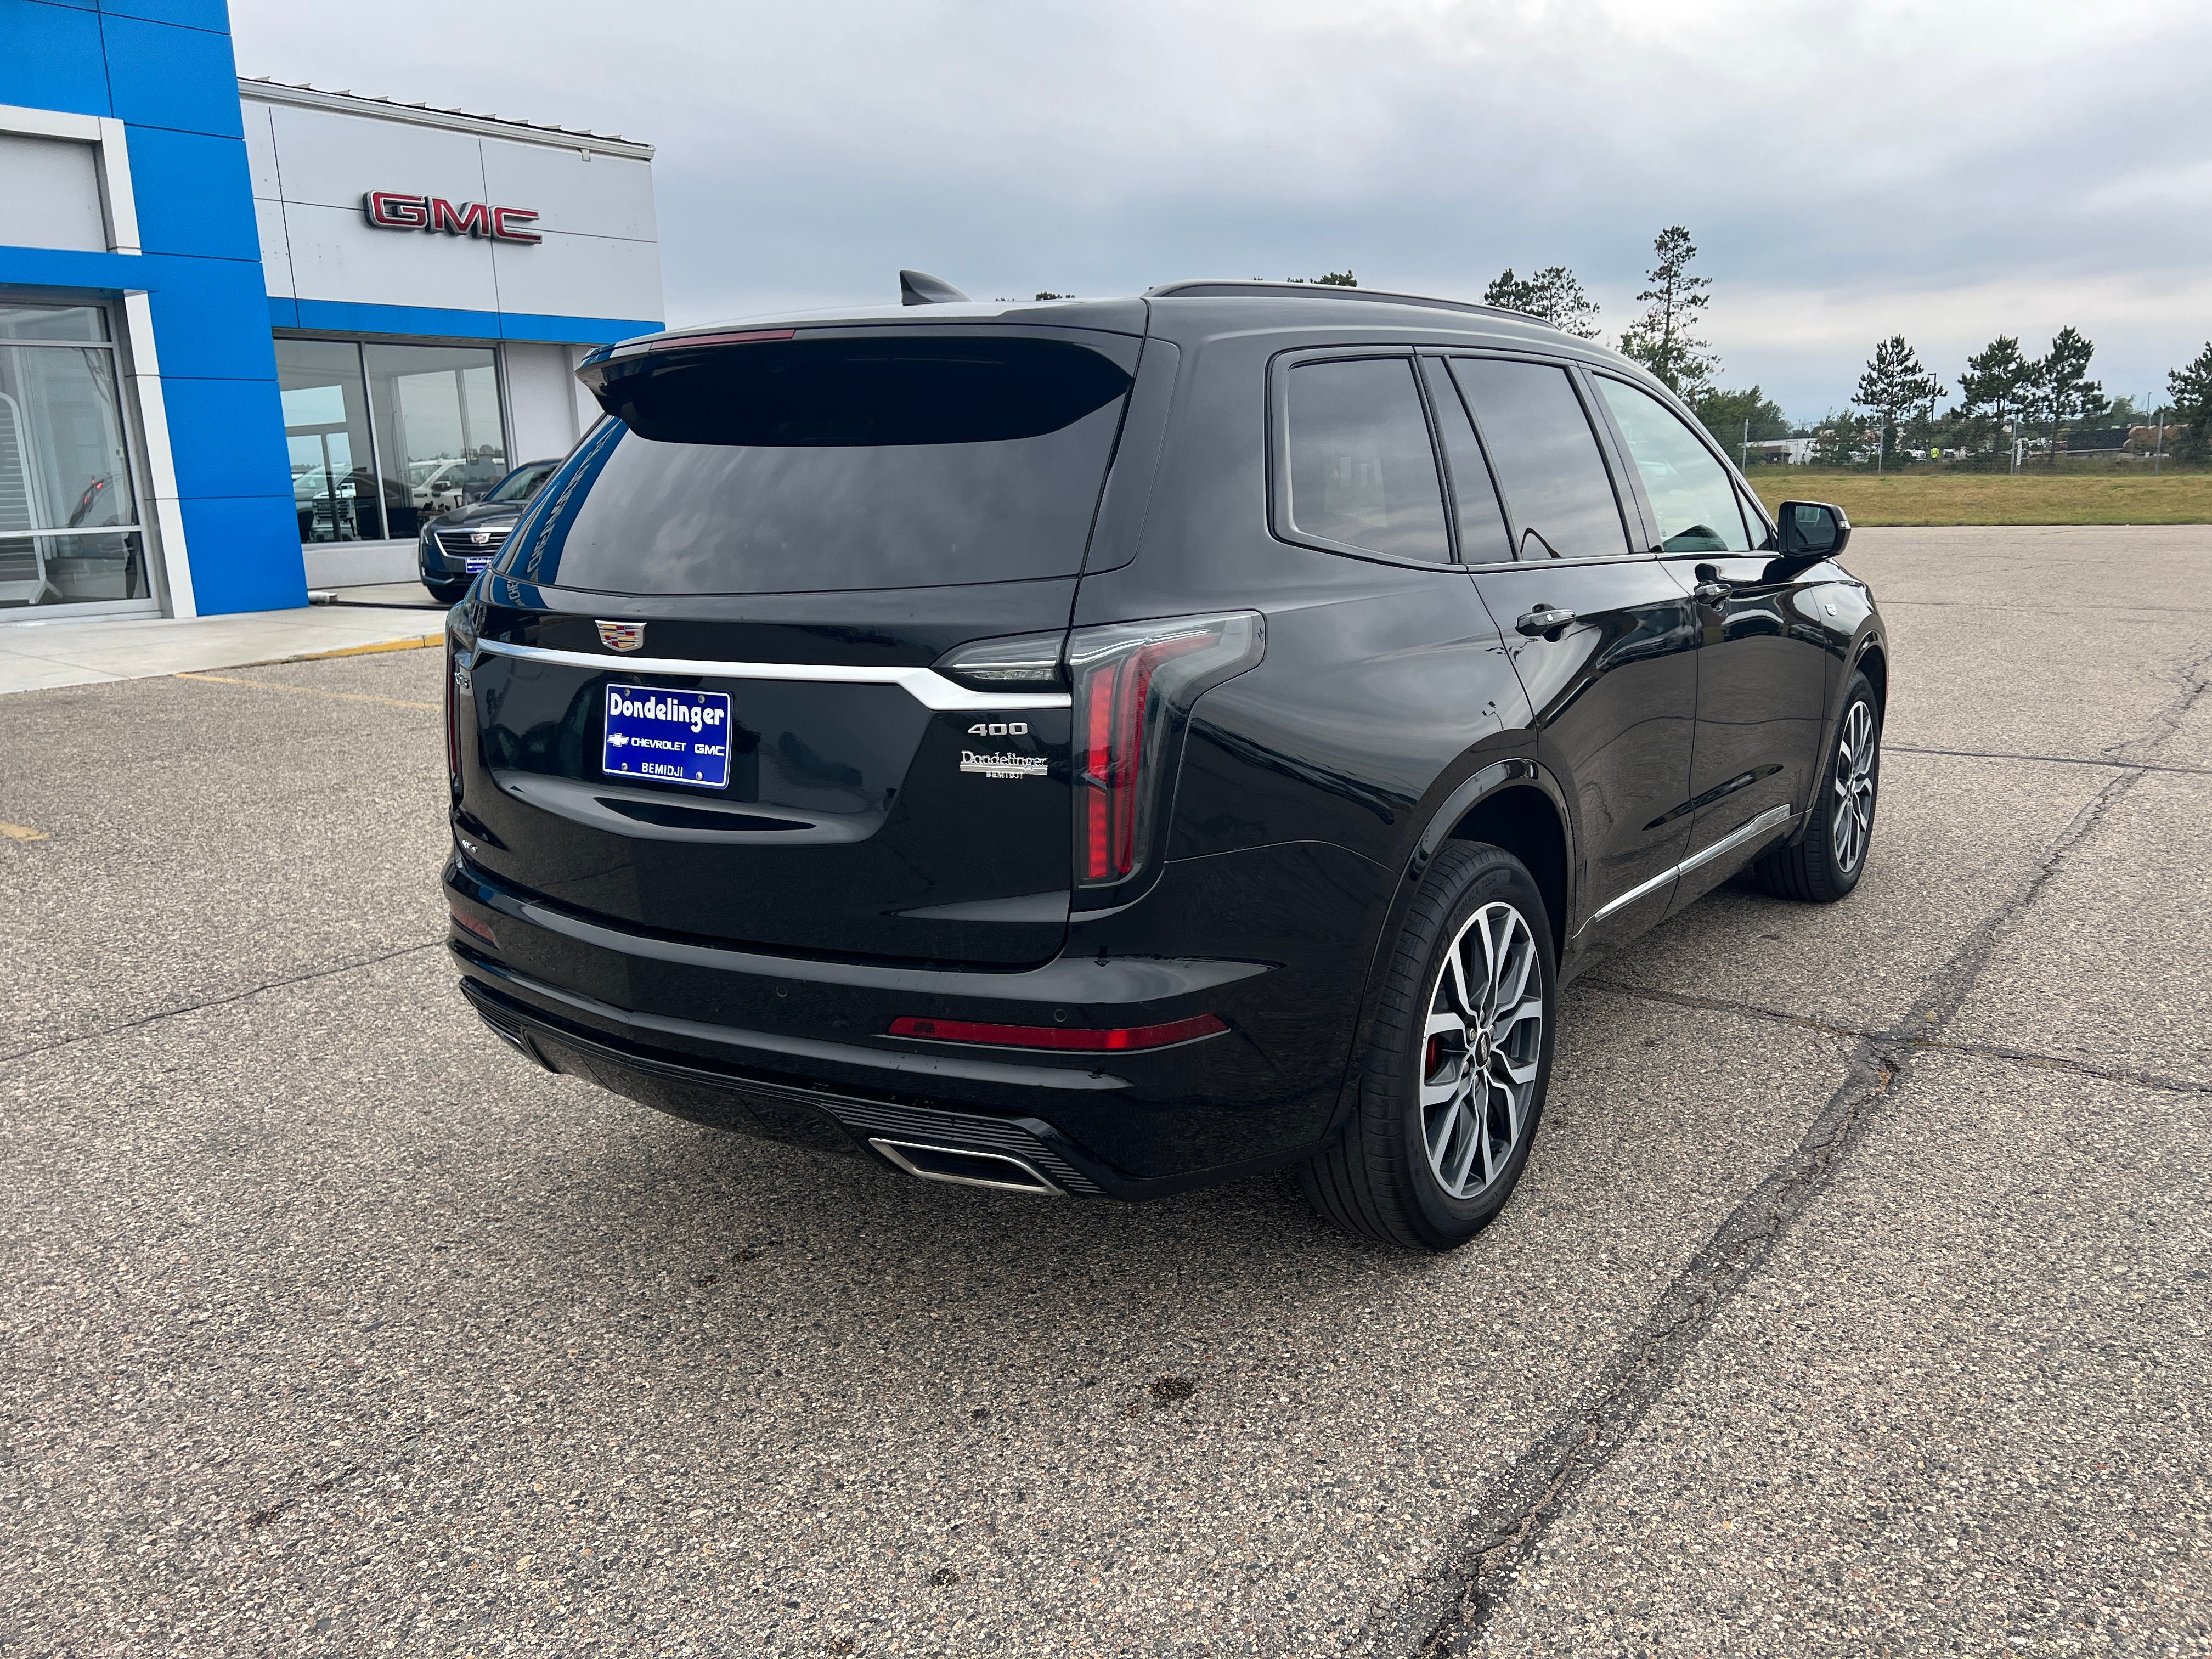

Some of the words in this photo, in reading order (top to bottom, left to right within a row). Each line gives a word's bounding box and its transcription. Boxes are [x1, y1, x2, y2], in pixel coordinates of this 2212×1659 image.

[363, 190, 543, 244] GMC
[610, 692, 724, 733] Dondelinger
[967, 722, 1028, 736] 400
[631, 737, 687, 752] CHEVROLET
[694, 743, 725, 756] GMC
[641, 762, 684, 777] BEMIDJI
[961, 751, 1048, 771] Dondelinger
